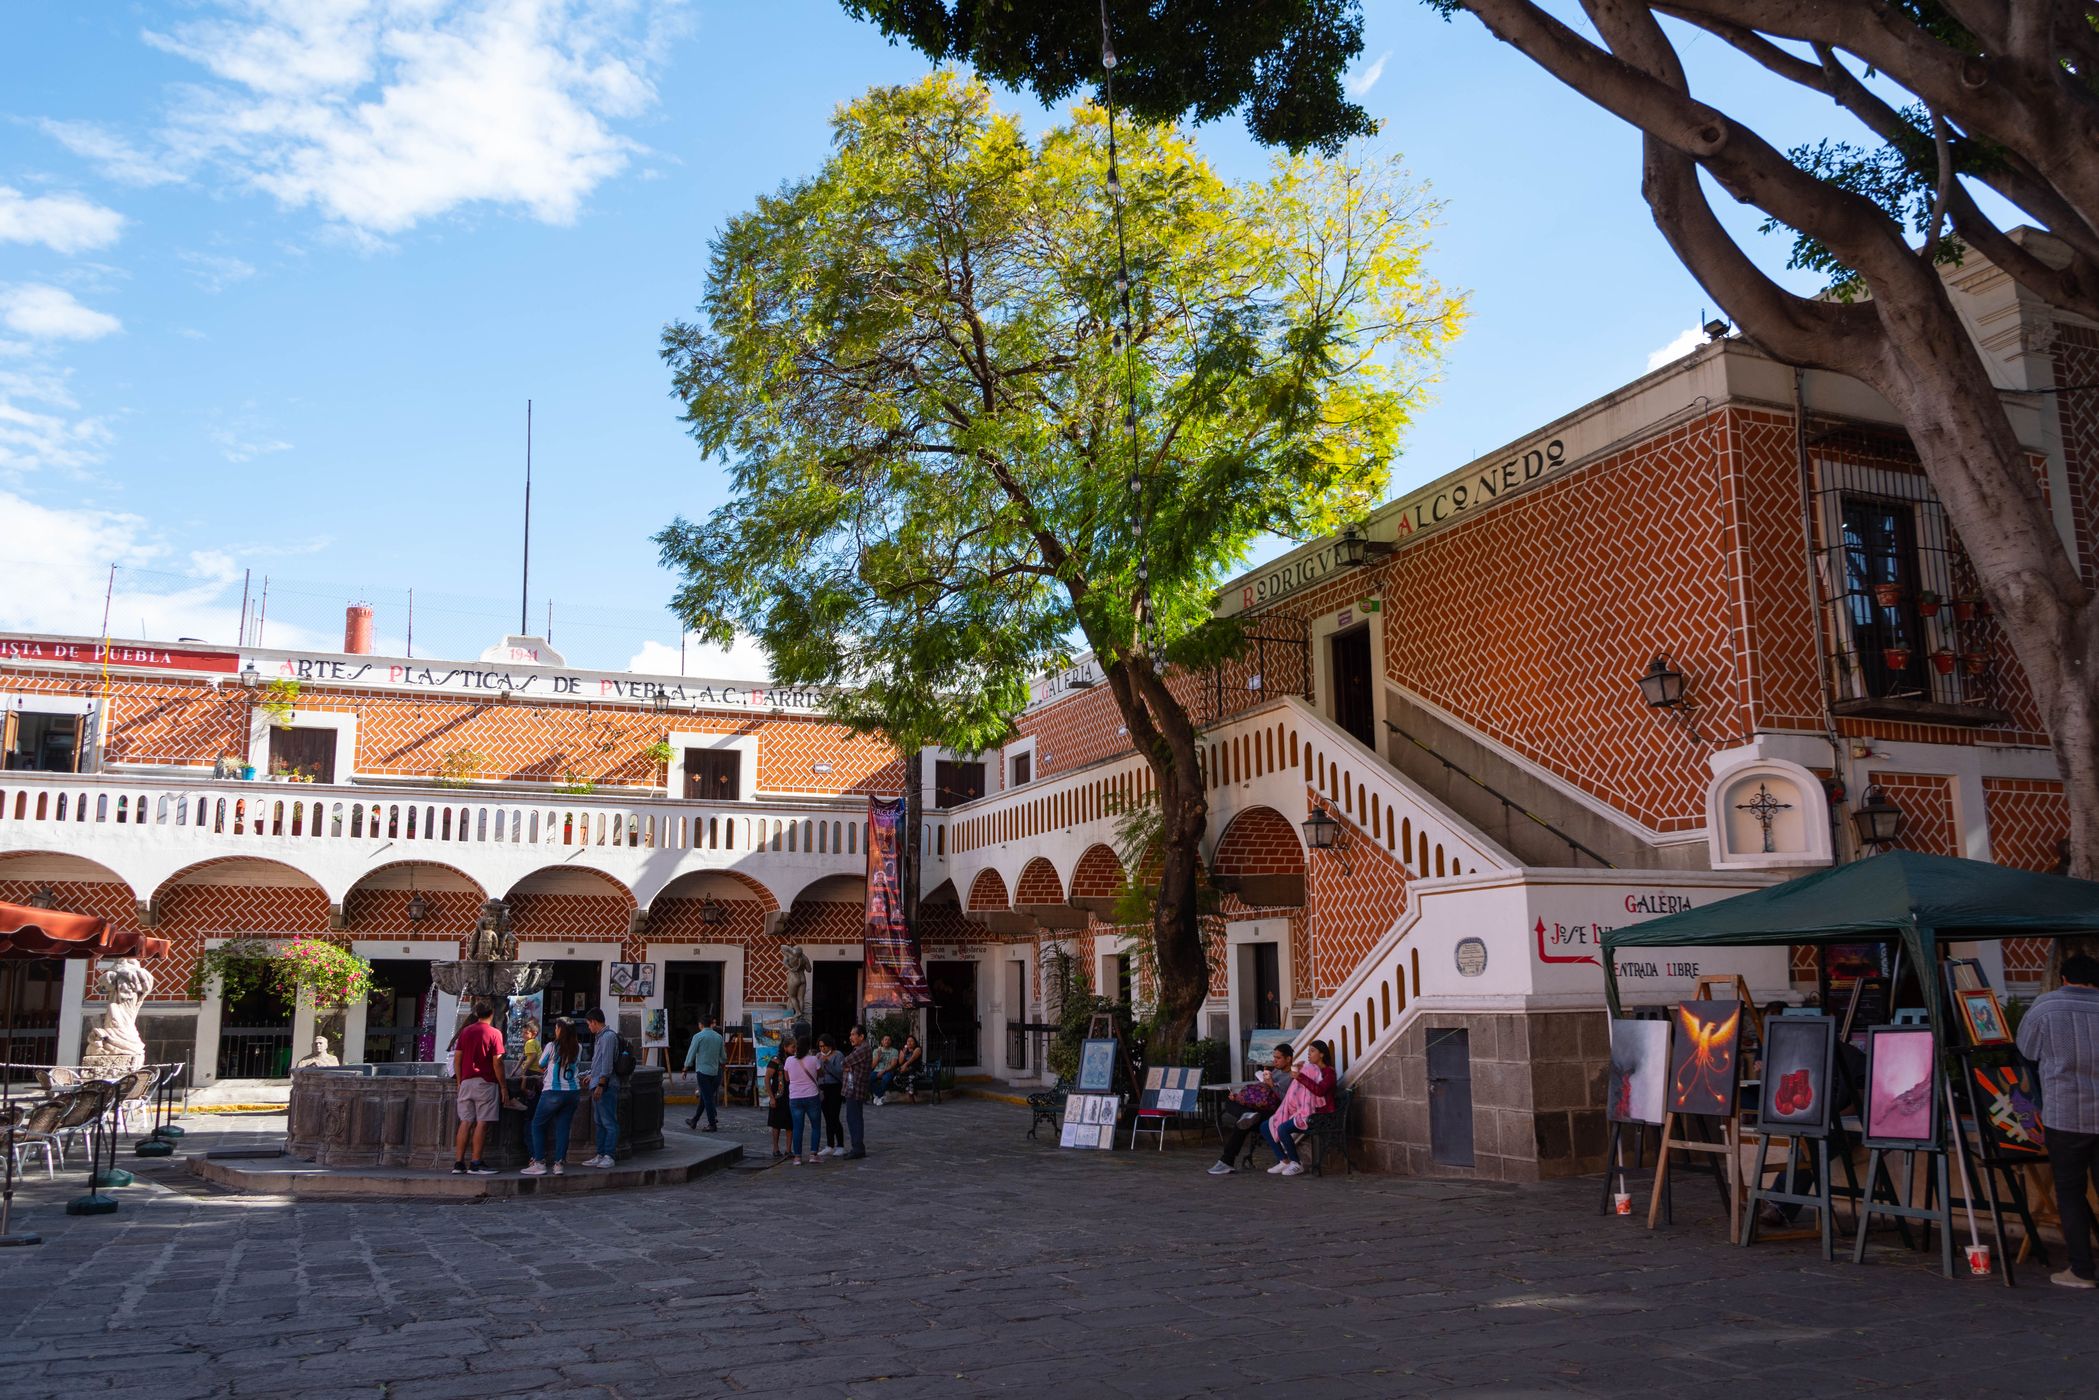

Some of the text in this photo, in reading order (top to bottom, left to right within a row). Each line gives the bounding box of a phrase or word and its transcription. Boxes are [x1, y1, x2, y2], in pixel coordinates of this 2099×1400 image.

[1397, 439, 1566, 538] ALCONEDO
[55, 645, 79, 658] DE
[94, 645, 172, 664] PUEBLA
[511, 648, 538, 661] 1941
[279, 658, 373, 680] ARTES
[388, 665, 538, 691] PLASTICAS
[553, 676, 582, 694] DE
[600, 679, 687, 701] PVEBA
[1042, 663, 1092, 700] GALERIA
[1550, 923, 1587, 945] JOSE
[1666, 962, 1700, 979] LIBRE
